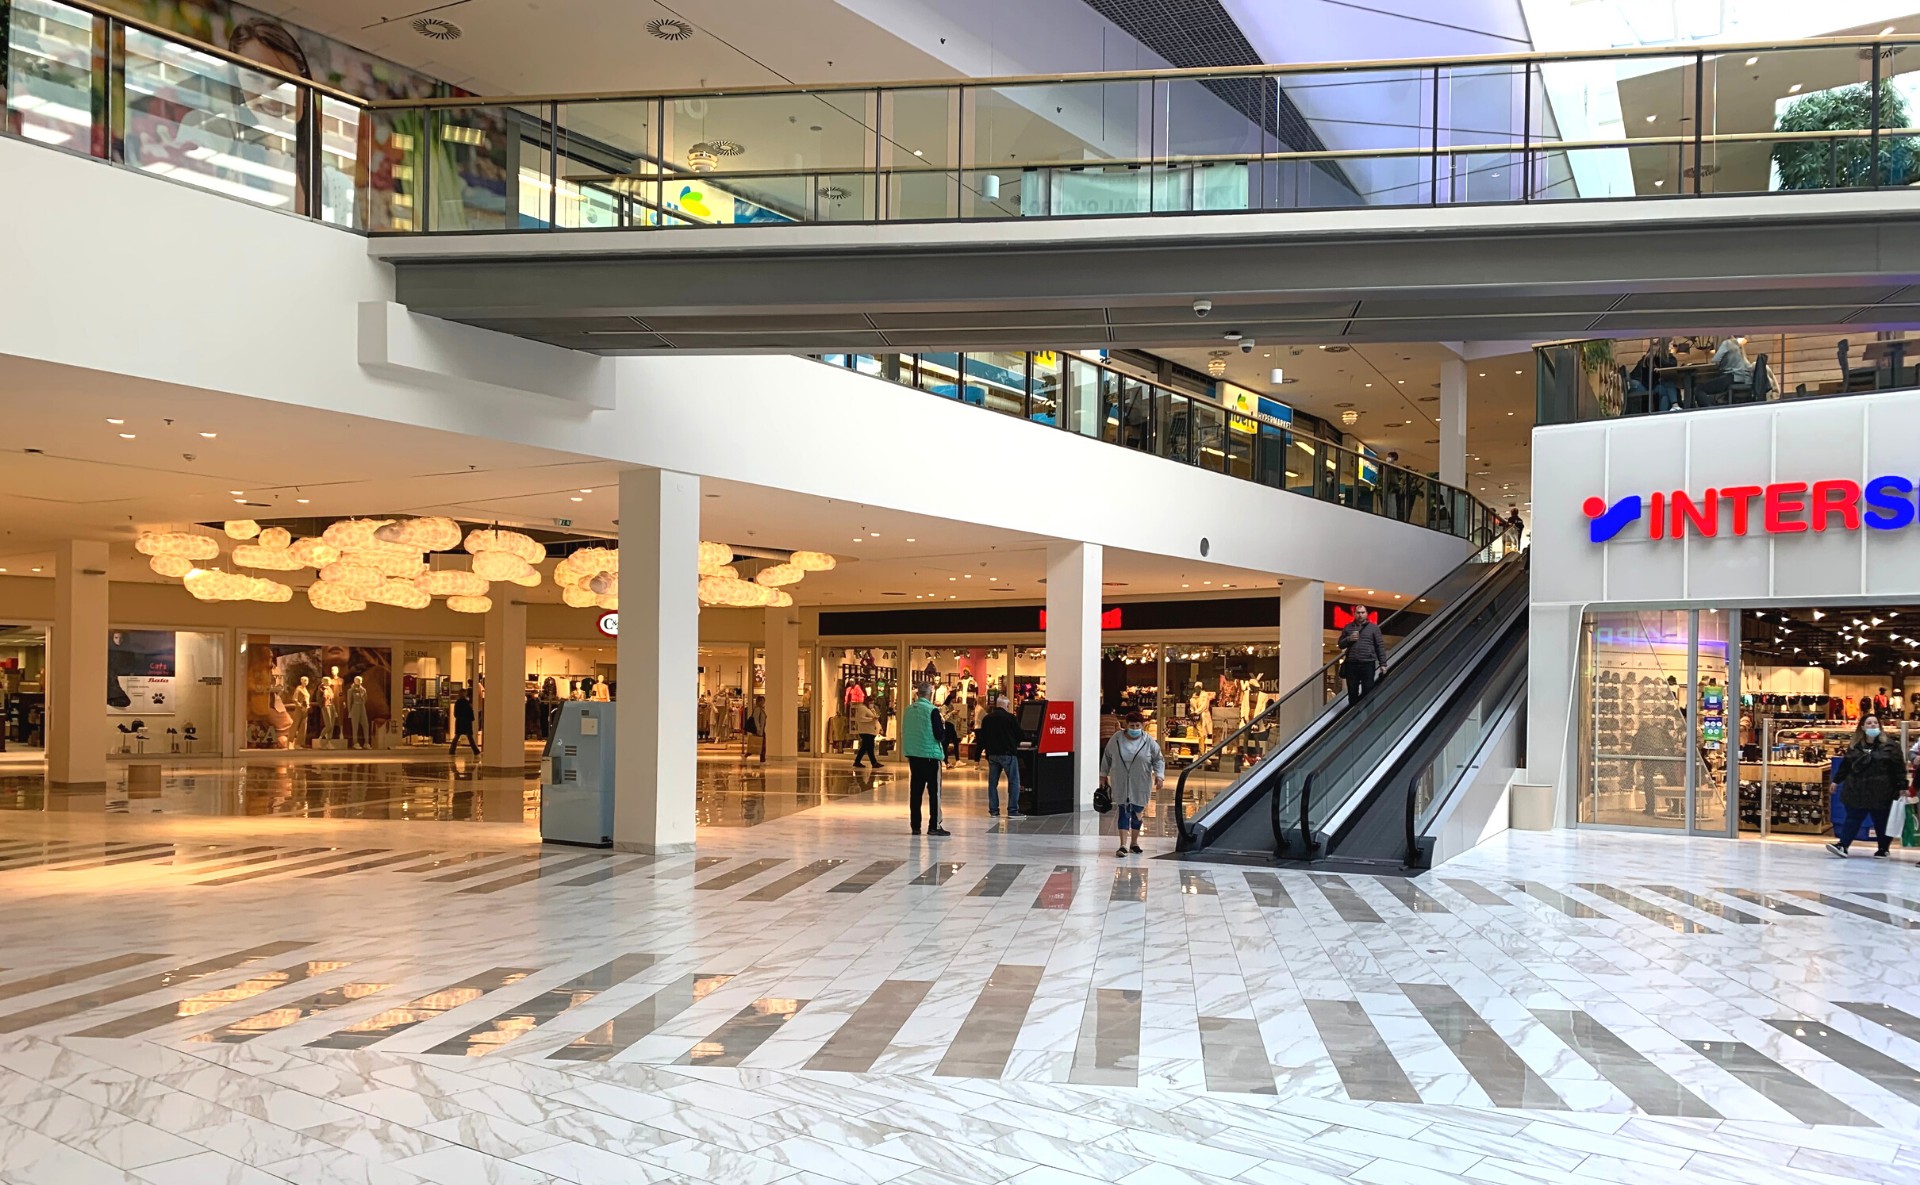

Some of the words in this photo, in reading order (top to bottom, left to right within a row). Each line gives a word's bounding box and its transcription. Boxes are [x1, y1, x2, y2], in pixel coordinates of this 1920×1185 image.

[1258, 411, 1292, 429] HYPERMARKET
[1649, 475, 1920, 541] INTERS
[603, 618, 618, 631] C&
[1049, 713, 1066, 721] VKLAD
[1049, 725, 1066, 735] VÝBĚR
